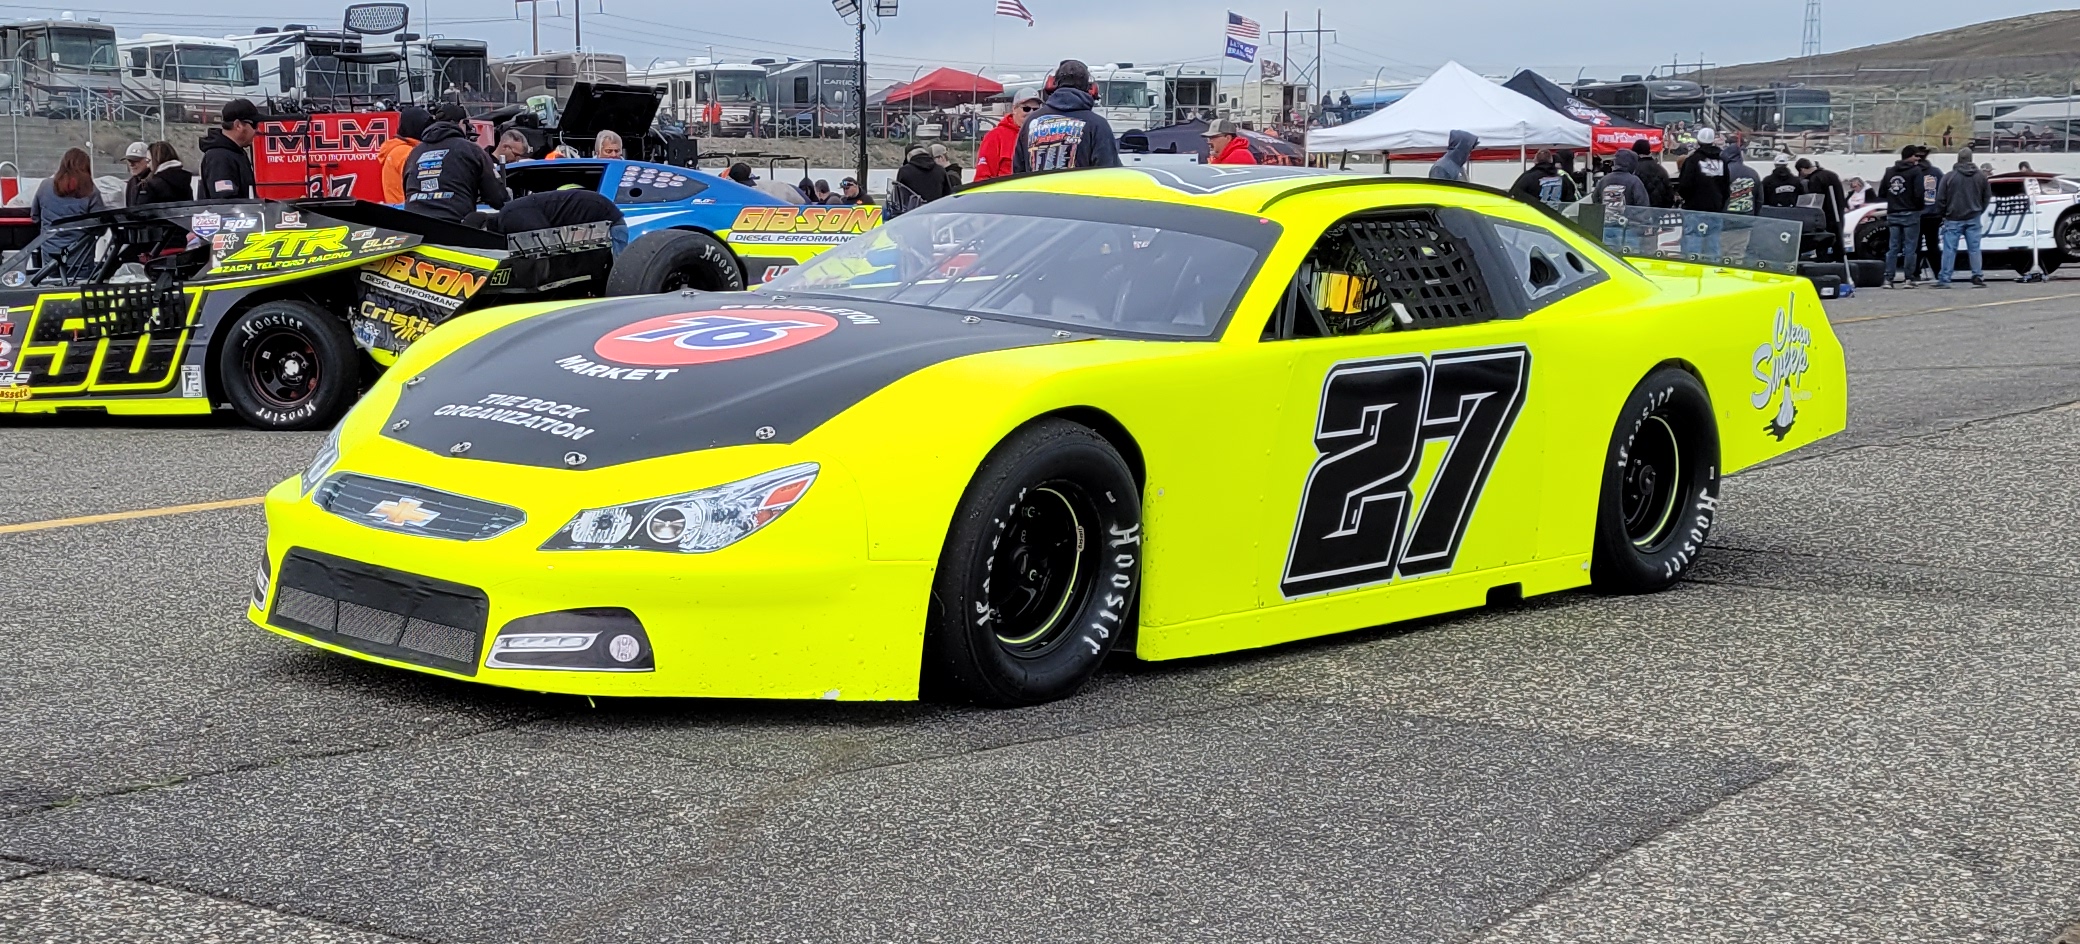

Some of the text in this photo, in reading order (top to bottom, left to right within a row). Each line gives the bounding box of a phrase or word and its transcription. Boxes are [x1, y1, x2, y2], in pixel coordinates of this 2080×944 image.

[264, 117, 390, 155] MLM
[328, 153, 381, 162] MOTORSPOR
[732, 206, 882, 232] GIBSON
[221, 226, 349, 262] ZTR
[734, 234, 858, 243] DIESEL PERFORMAN
[256, 258, 305, 270] TELFORD
[308, 250, 352, 264] RACING
[700, 244, 739, 289] Hoosie
[490, 267, 512, 287] 50
[394, 283, 462, 310] PERFORMANC
[241, 312, 304, 341] Hoosier
[720, 304, 881, 325] PENDLETON
[14, 286, 204, 394] 50
[612, 315, 826, 350] 76
[555, 354, 680, 382] MARKET
[1750, 342, 1809, 411] Sweep
[255, 399, 317, 426] Hoosier
[477, 393, 591, 419] THE BOCK
[433, 403, 596, 441] ORGANIZATION
[1279, 342, 1533, 601] 27
[1664, 487, 1719, 579] Hoosier
[1082, 522, 1141, 655] Hoosier
